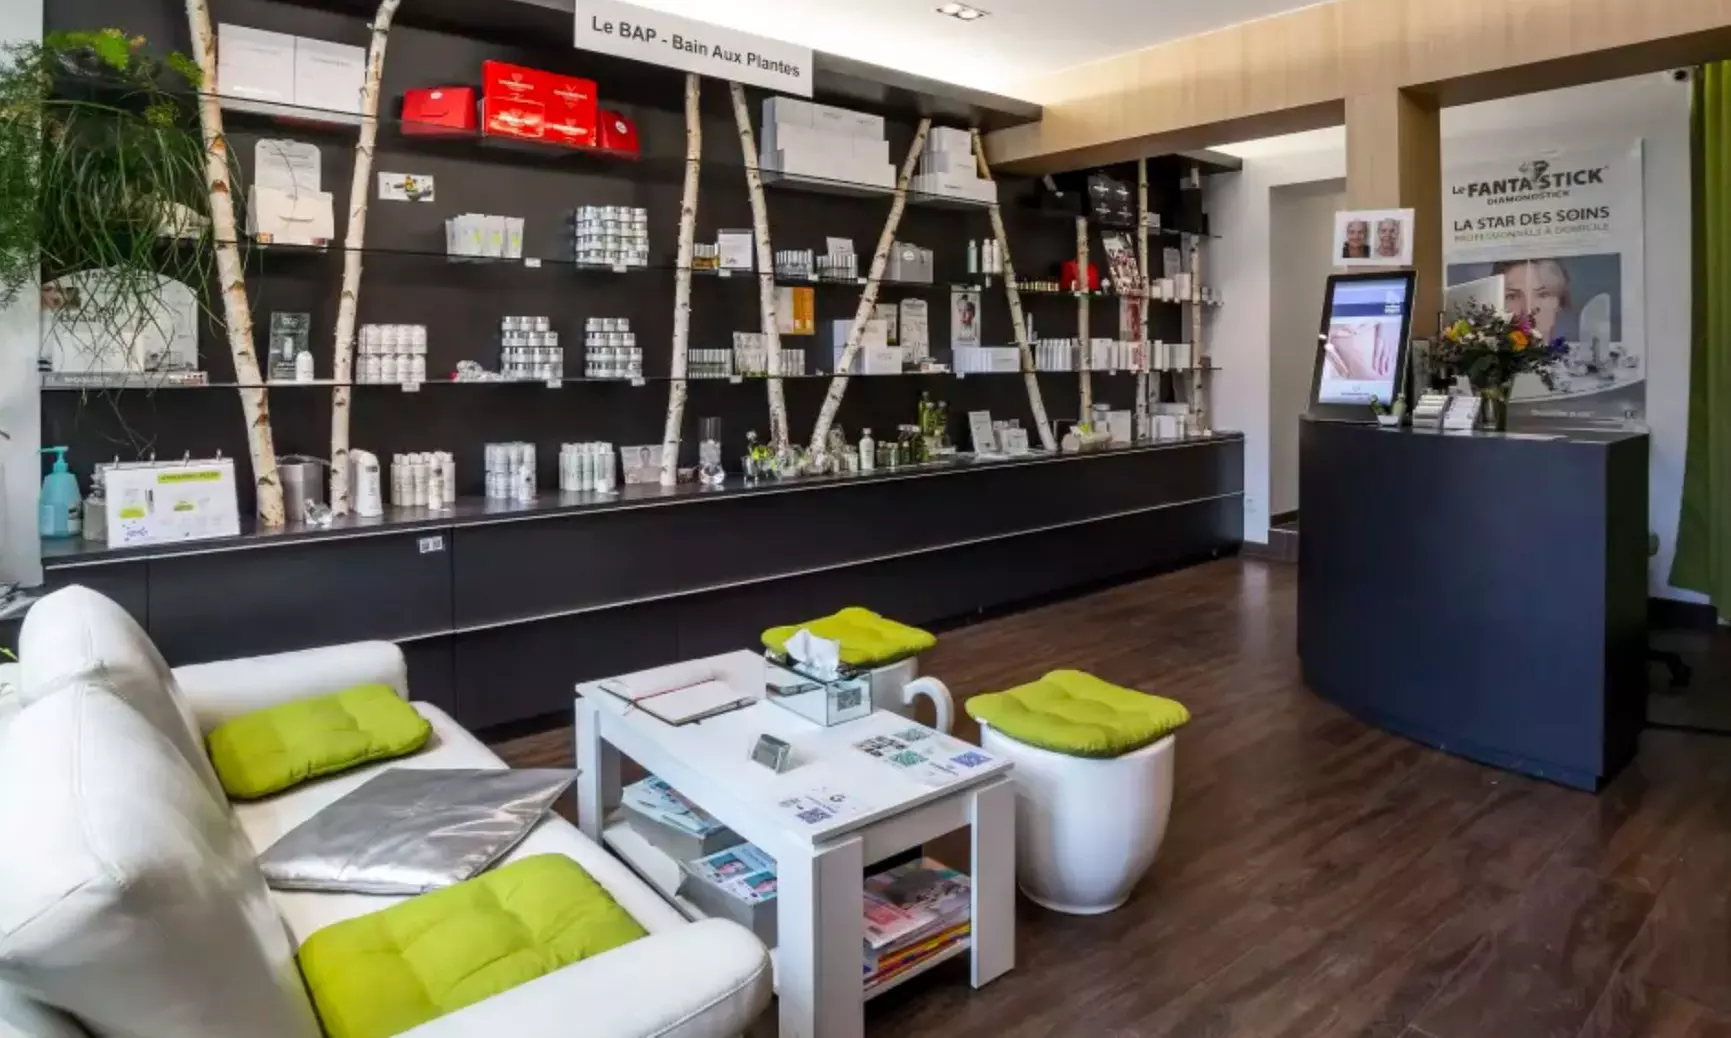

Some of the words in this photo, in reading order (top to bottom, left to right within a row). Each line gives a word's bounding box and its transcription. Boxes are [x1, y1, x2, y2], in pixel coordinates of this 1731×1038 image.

[592, 15, 613, 33] Le
[619, 21, 657, 43] BAP
[672, 34, 709, 56] Bain
[712, 44, 742, 65] Aux
[746, 51, 801, 78] Plantes
[1452, 185, 1466, 195] Le
[1487, 190, 1570, 205] DIAMONDSTICK
[1453, 219, 1474, 232] LA
[1476, 215, 1516, 230] STAR
[1519, 211, 1552, 226] DES
[1556, 206, 1610, 223] SOINS
